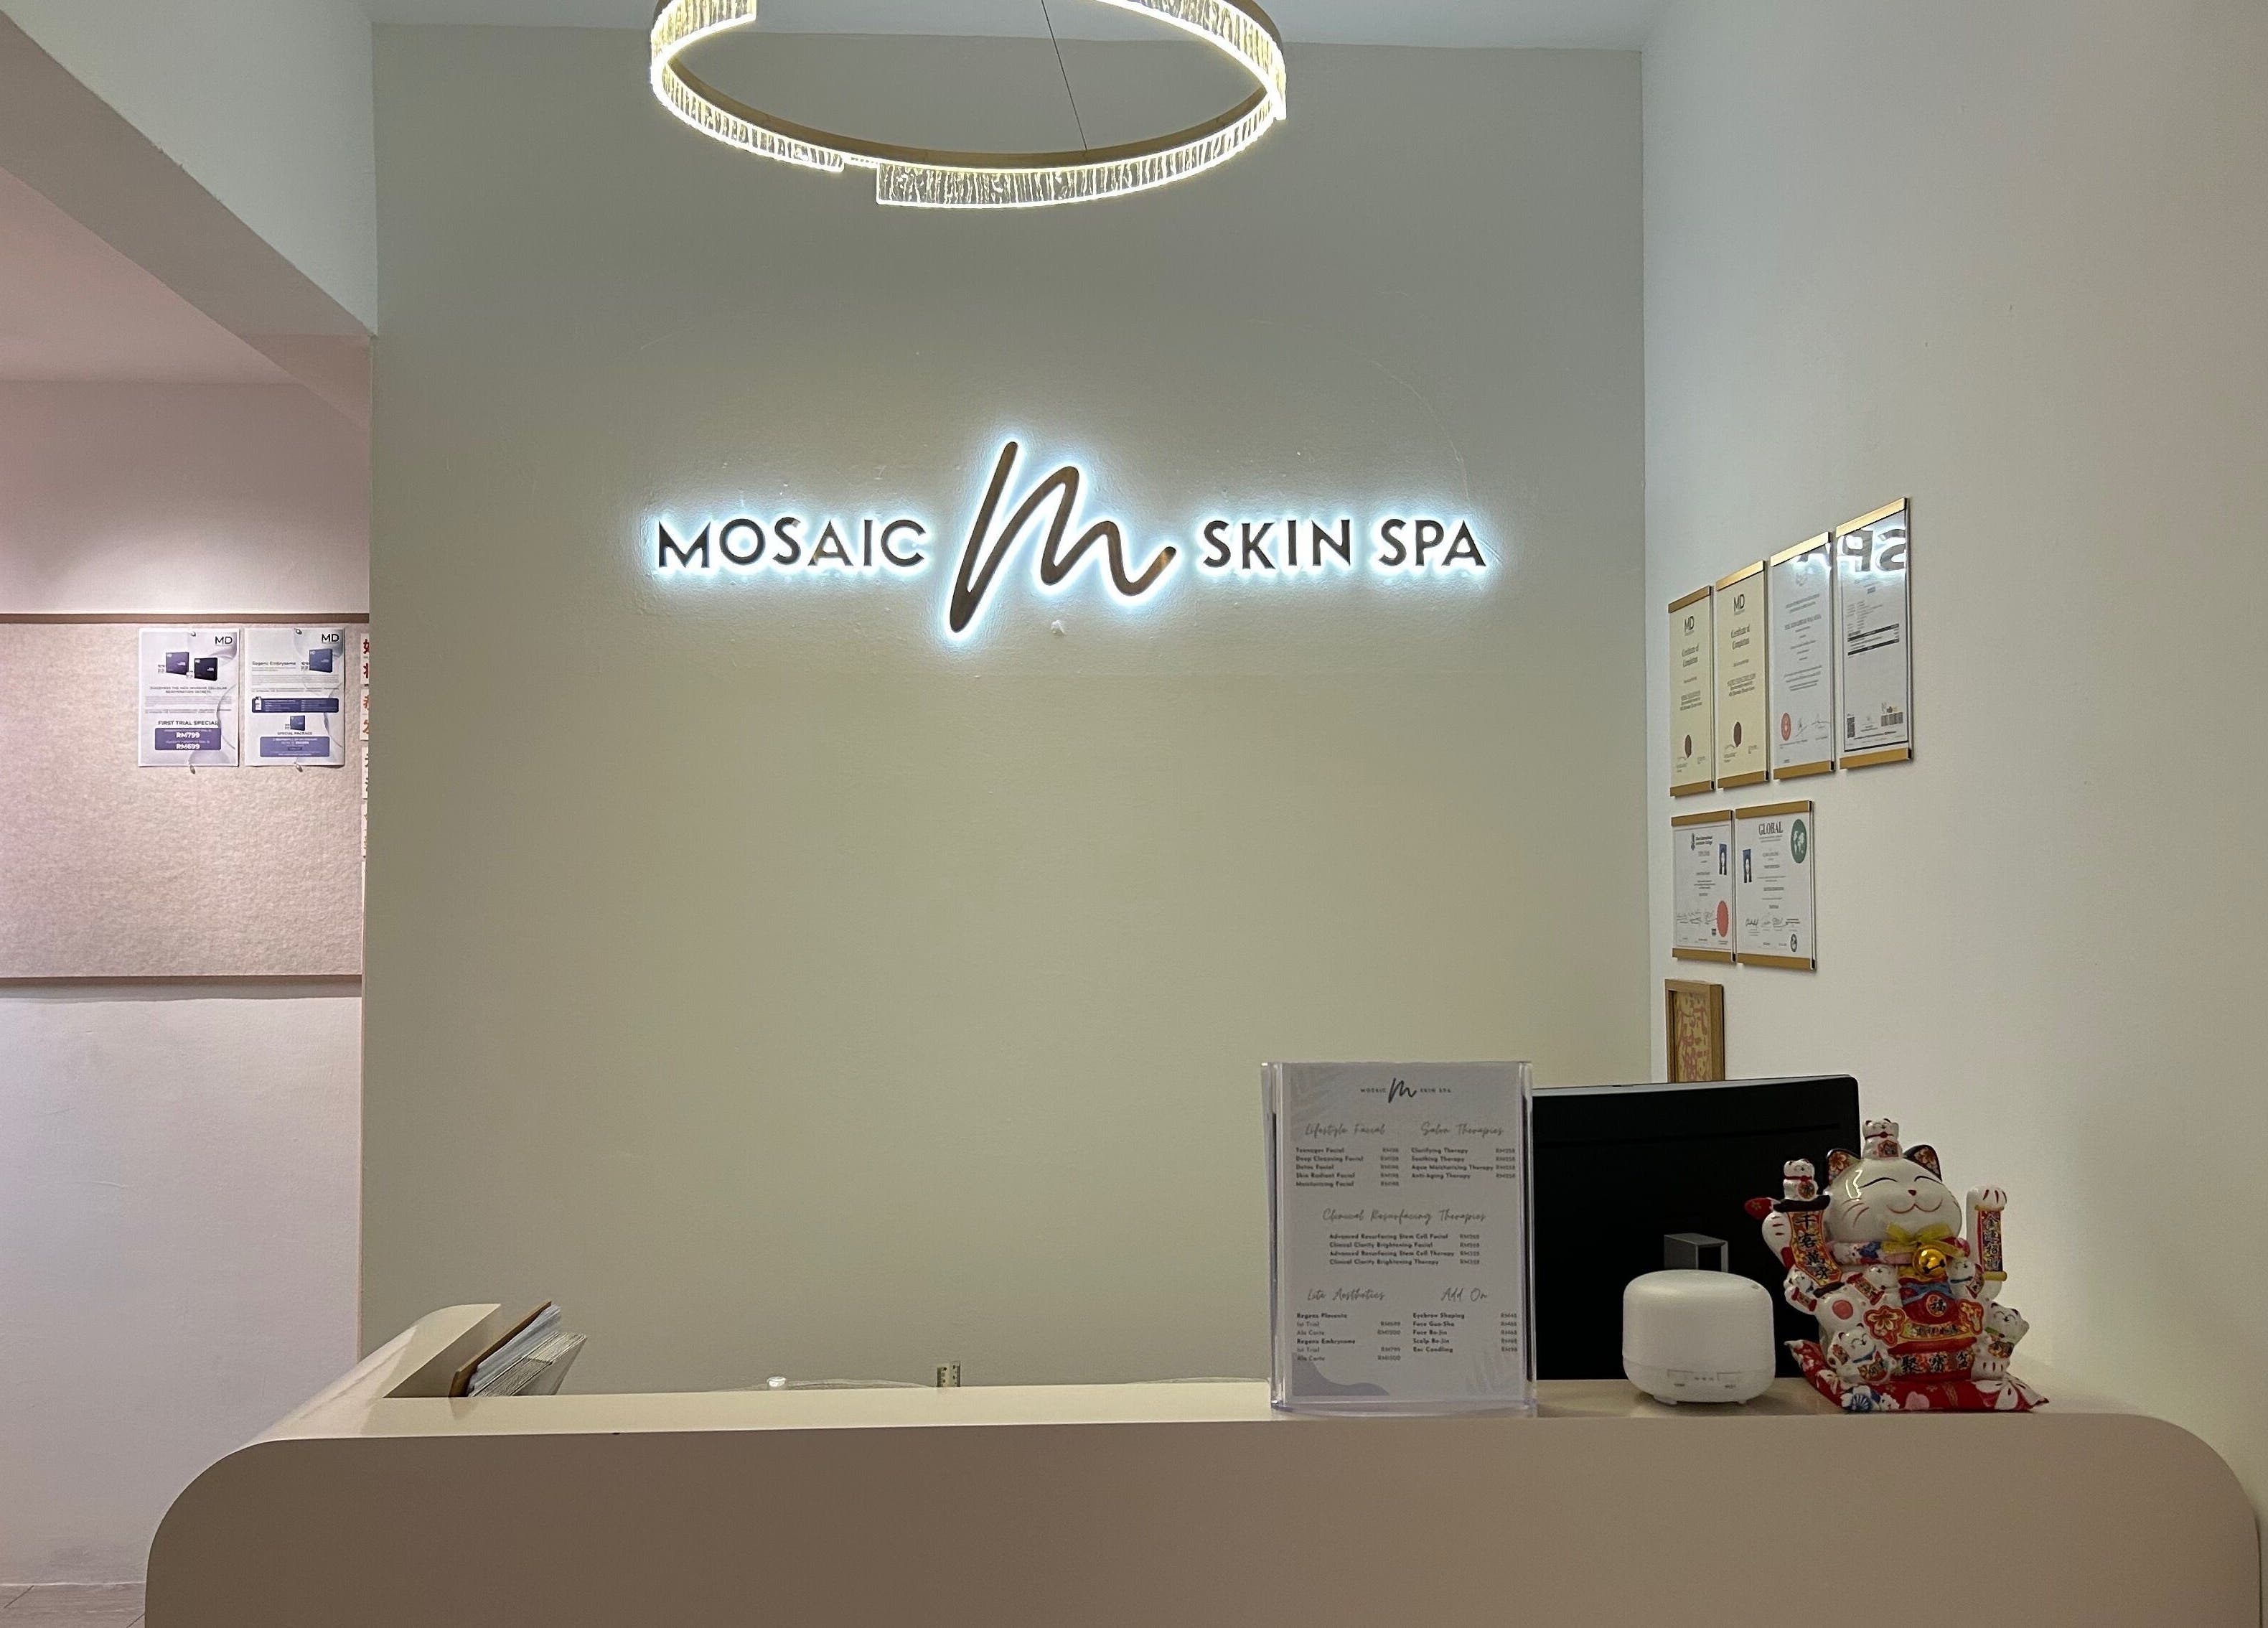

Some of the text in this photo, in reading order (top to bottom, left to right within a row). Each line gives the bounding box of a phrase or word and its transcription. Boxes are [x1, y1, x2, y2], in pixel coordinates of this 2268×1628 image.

[657, 518, 925, 568] MOSAIC
[1203, 519, 1351, 569] SKIN
[1379, 519, 1486, 568] SPA
[1733, 594, 1745, 612] MD
[1684, 615, 1695, 632] MD
[215, 636, 233, 645] MD
[322, 634, 339, 642] MD
[1758, 821, 1784, 836] GLOBAL
[1305, 1123, 1385, 1137] Lifestyle Facial
[1421, 1121, 1504, 1137] Salon Therapies
[1369, 1208, 1433, 1225] Resurfacing
[1438, 1209, 1487, 1223] Therapies
[1441, 1287, 1488, 1302] Add On
